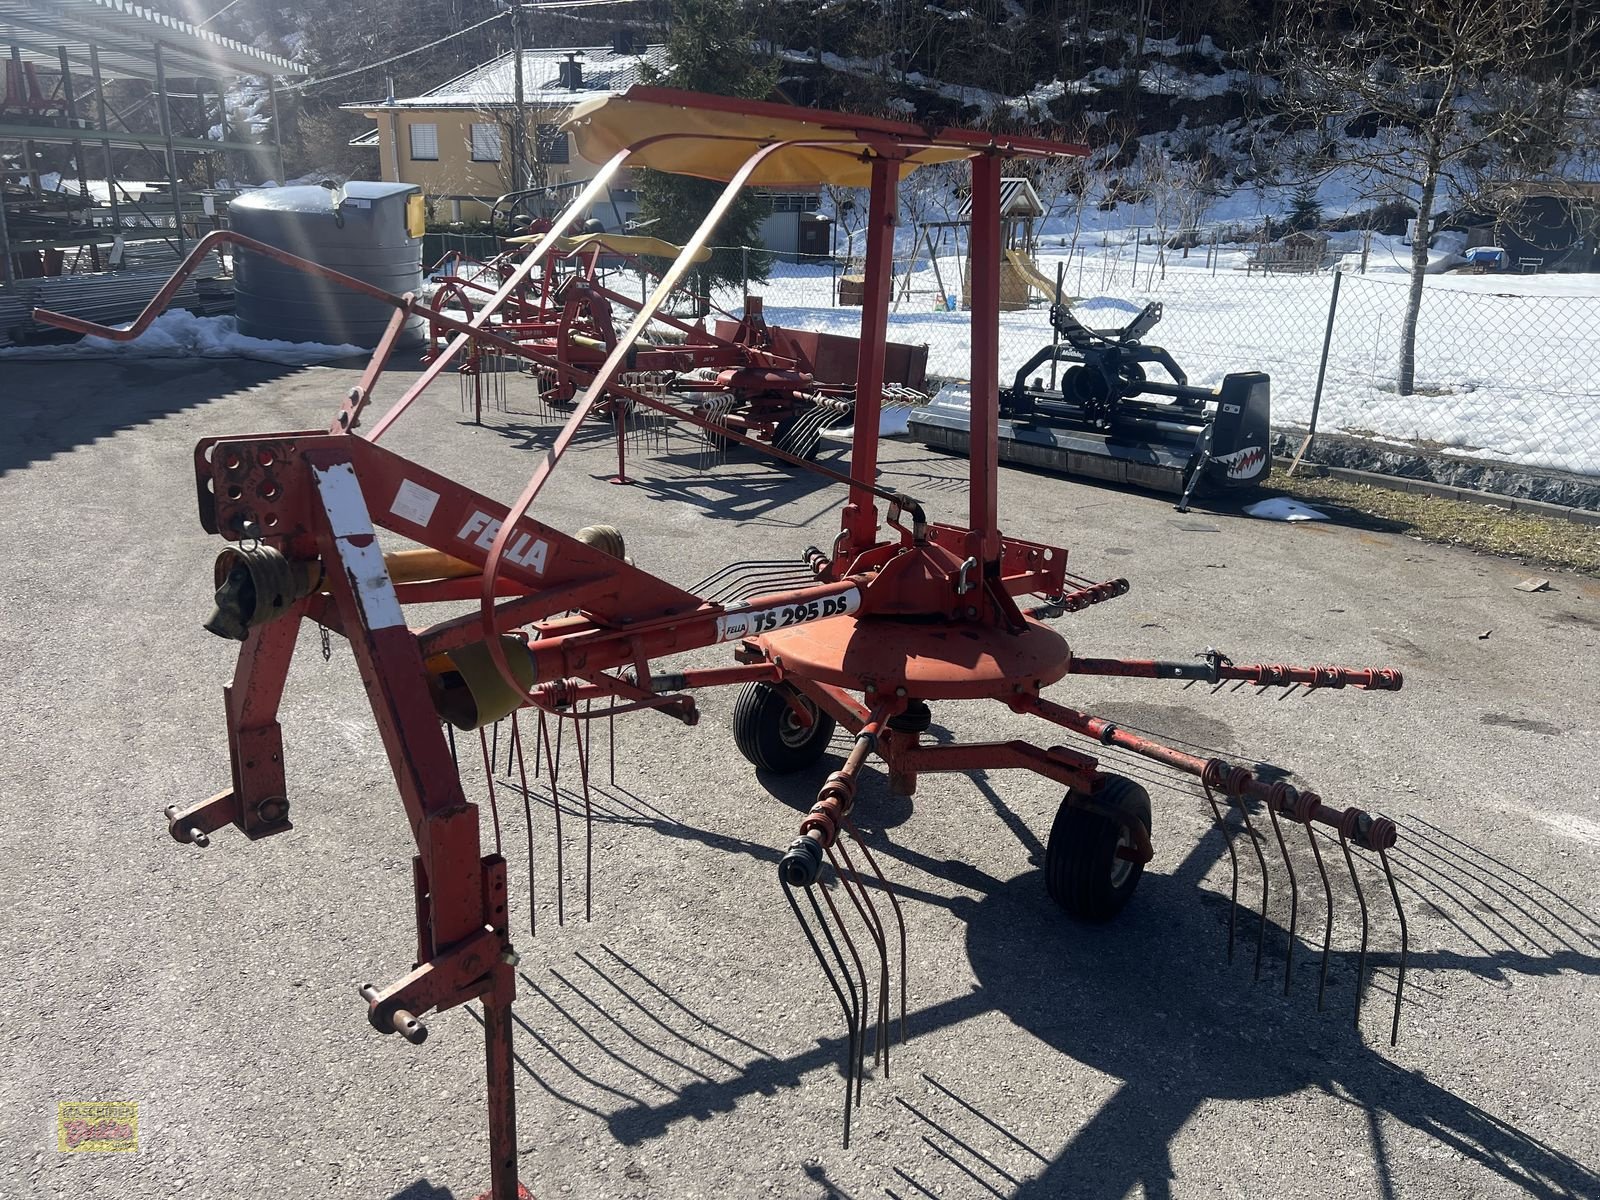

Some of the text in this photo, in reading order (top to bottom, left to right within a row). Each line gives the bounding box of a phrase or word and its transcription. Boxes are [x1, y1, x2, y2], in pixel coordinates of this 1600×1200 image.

[753, 595, 847, 633] TS 295 DS
[726, 623, 746, 635] FELLA
